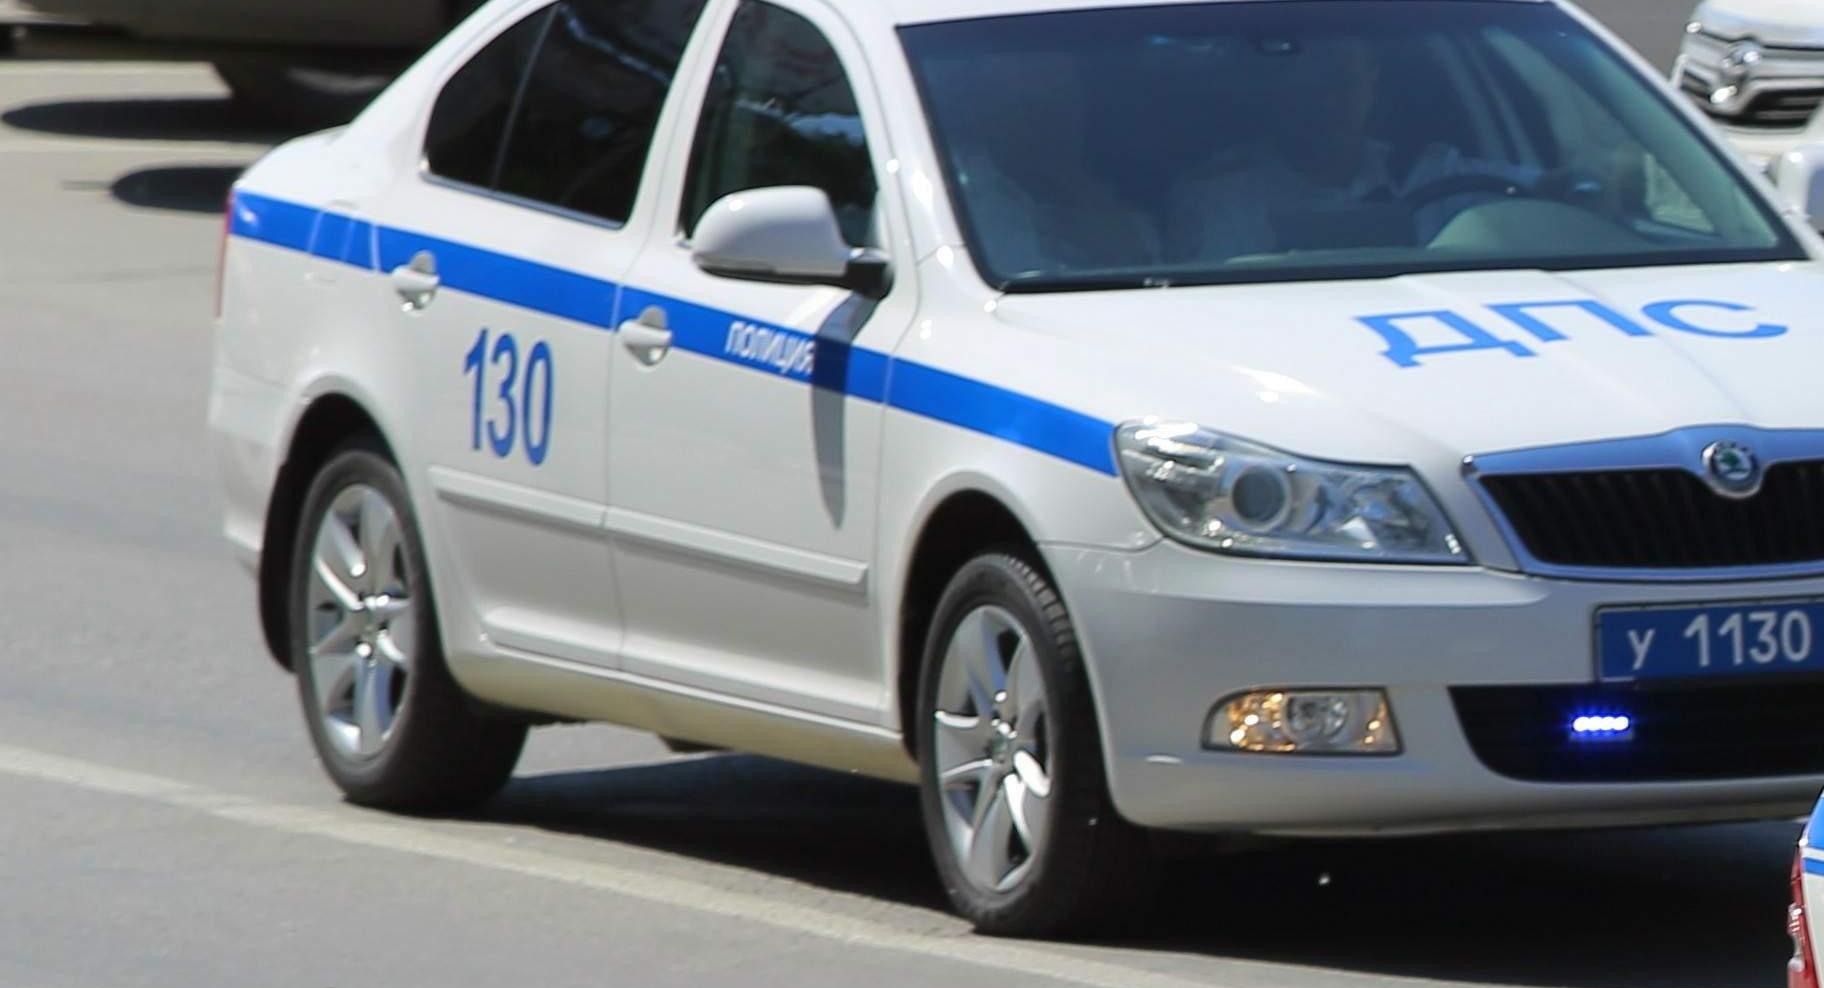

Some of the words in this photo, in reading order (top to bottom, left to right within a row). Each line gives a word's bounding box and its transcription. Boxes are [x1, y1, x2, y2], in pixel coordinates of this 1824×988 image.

[1353, 299, 1789, 368] ДПС
[464, 328, 554, 467] 130
[1684, 610, 1812, 668] 1130
